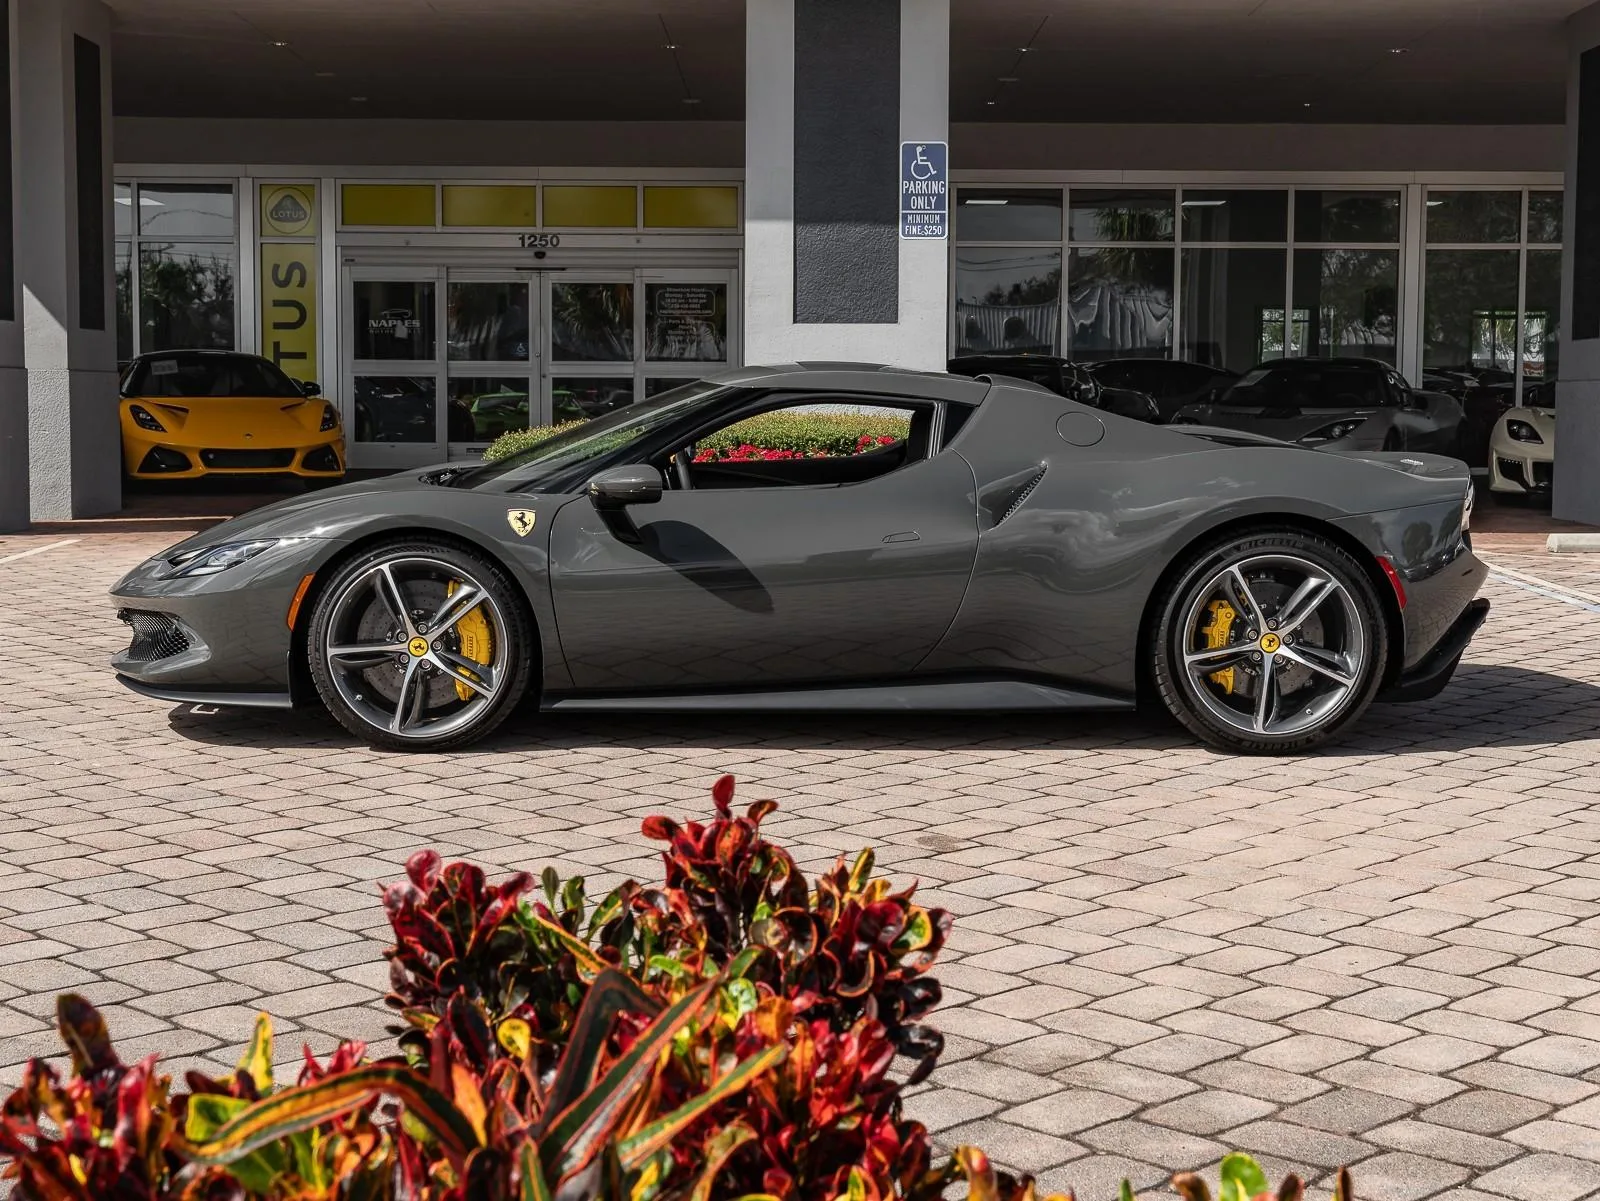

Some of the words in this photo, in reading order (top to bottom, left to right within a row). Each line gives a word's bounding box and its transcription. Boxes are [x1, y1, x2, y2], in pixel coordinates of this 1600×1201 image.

[903, 180, 945, 194] PARKING
[910, 196, 937, 209] ONLY
[272, 210, 305, 218] LOTUS
[907, 214, 940, 223] MINIMUM
[905, 225, 922, 235] FINE
[924, 224, 942, 235] $250
[518, 233, 560, 248] 1250
